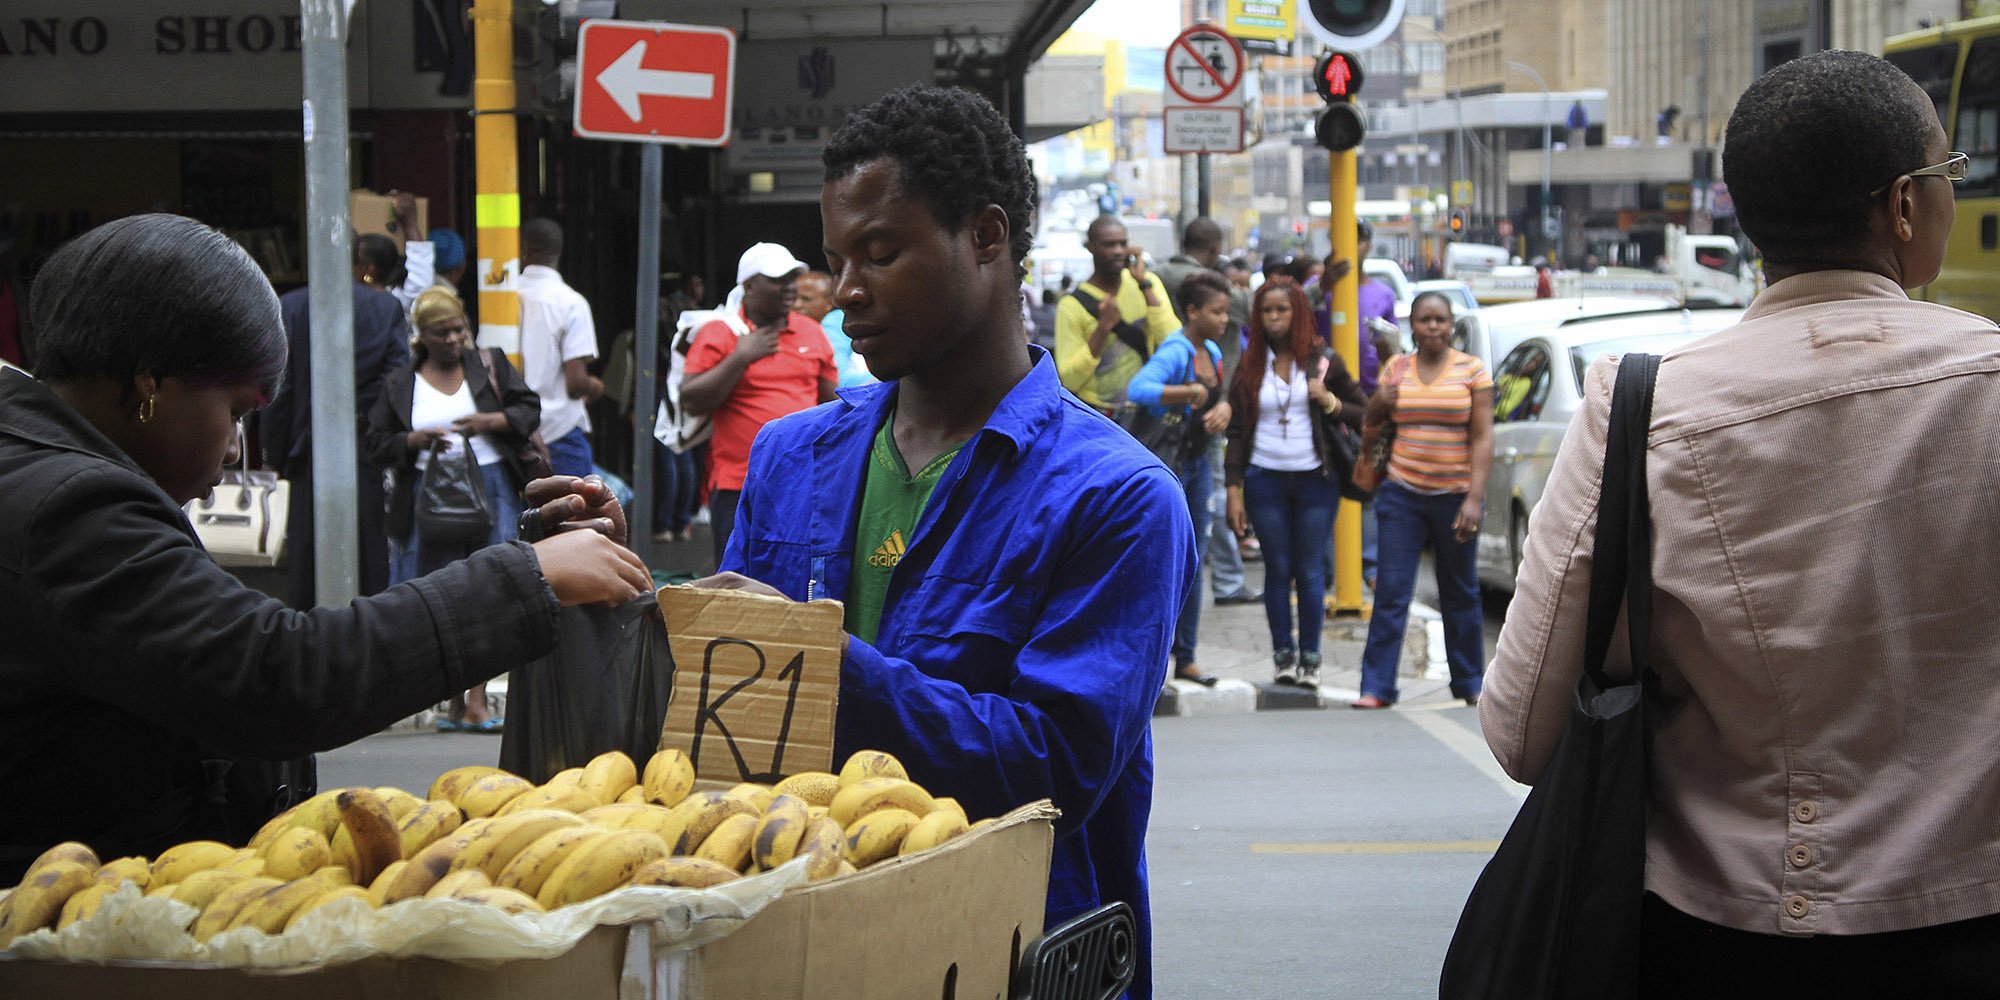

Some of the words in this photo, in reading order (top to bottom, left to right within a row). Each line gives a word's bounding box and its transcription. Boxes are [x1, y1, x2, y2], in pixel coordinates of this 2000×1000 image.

[154, 15, 351, 54] SHOE
[867, 552, 902, 567] adid
[690, 636, 805, 785] R1
